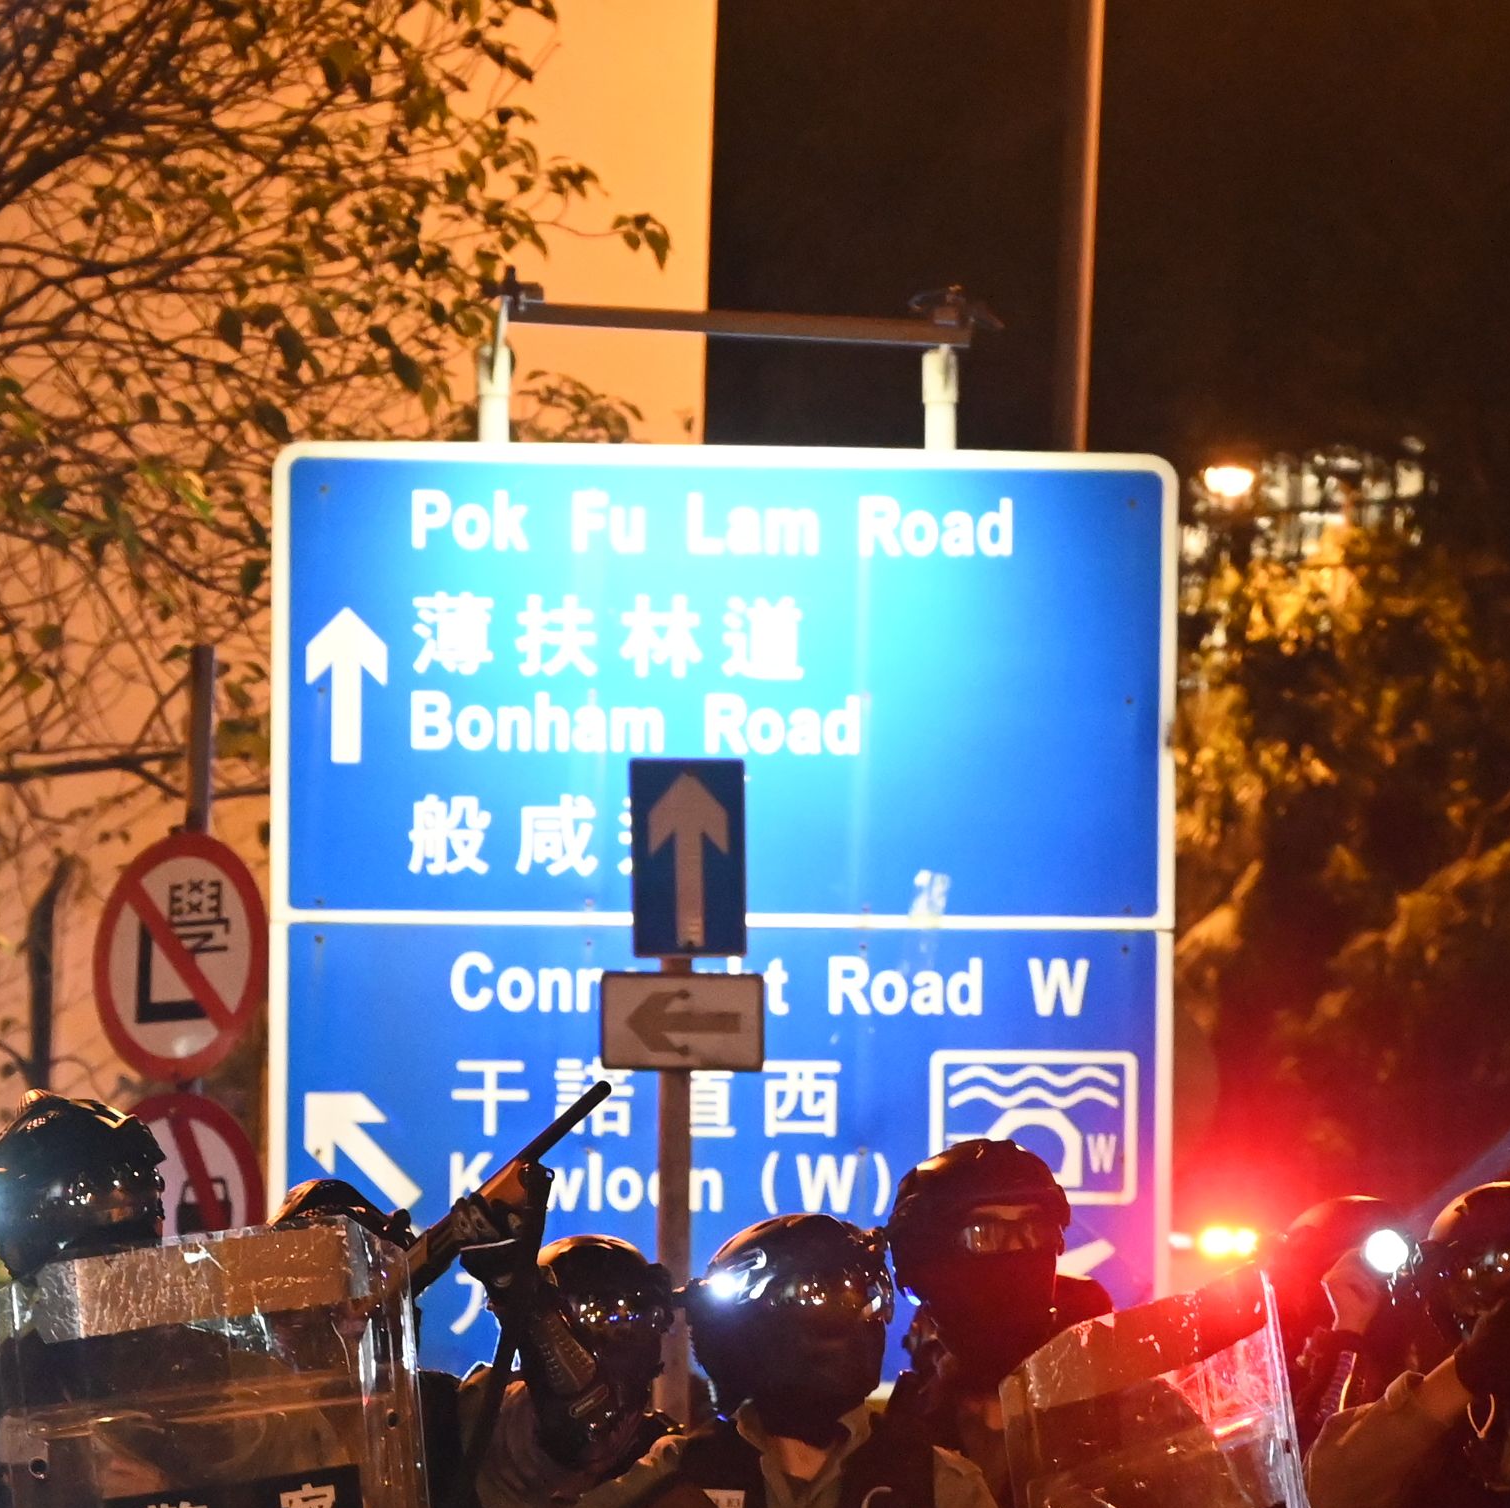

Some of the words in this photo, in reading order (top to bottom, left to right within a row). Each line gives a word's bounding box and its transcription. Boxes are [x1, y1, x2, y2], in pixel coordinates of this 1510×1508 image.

[411, 489, 528, 552] Pok
[572, 490, 647, 553] Fu
[688, 493, 819, 555] Lam
[859, 496, 1015, 558] Road
[411, 592, 805, 680] 薄扶林道
[410, 690, 664, 754] Bonham
[704, 693, 862, 756] Road
[408, 793, 633, 877] 般咸
[450, 951, 789, 1017] Connt
[827, 956, 982, 1017] Road
[1029, 957, 1091, 1018] W
[449, 1151, 724, 1213] Kwlon
[760, 1151, 891, 1216] (W)
[1086, 1133, 1118, 1174] W
